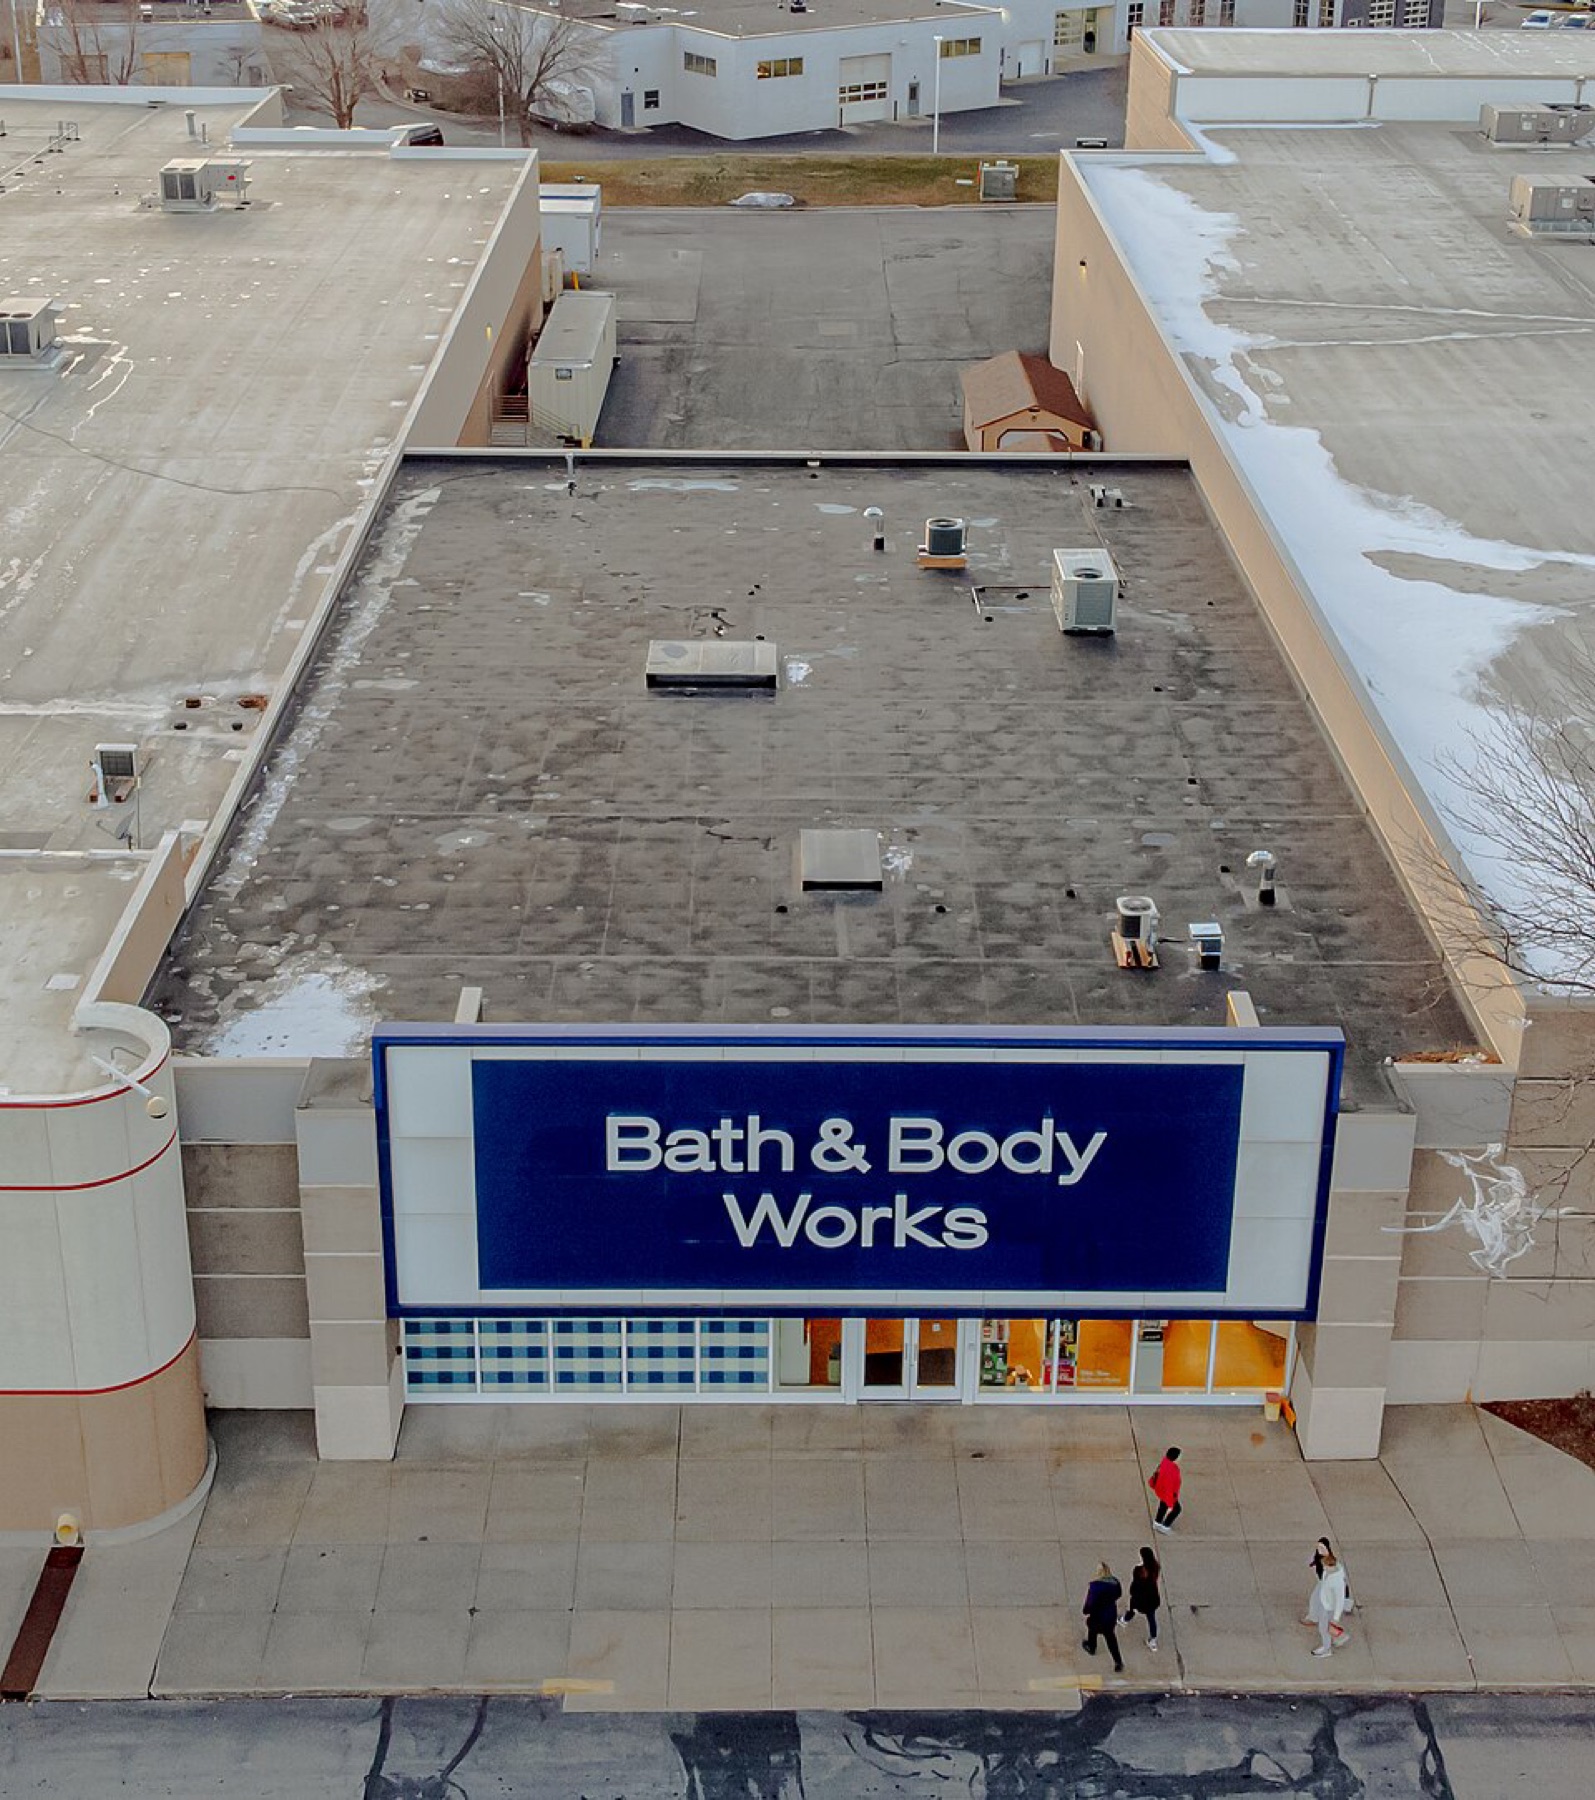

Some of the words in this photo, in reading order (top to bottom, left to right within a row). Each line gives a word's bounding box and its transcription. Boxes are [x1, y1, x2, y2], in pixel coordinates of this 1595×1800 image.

[605, 1115, 794, 1173] Bath
[810, 1117, 872, 1174] &
[888, 1117, 1108, 1186] Body
[722, 1193, 989, 1248] Works
